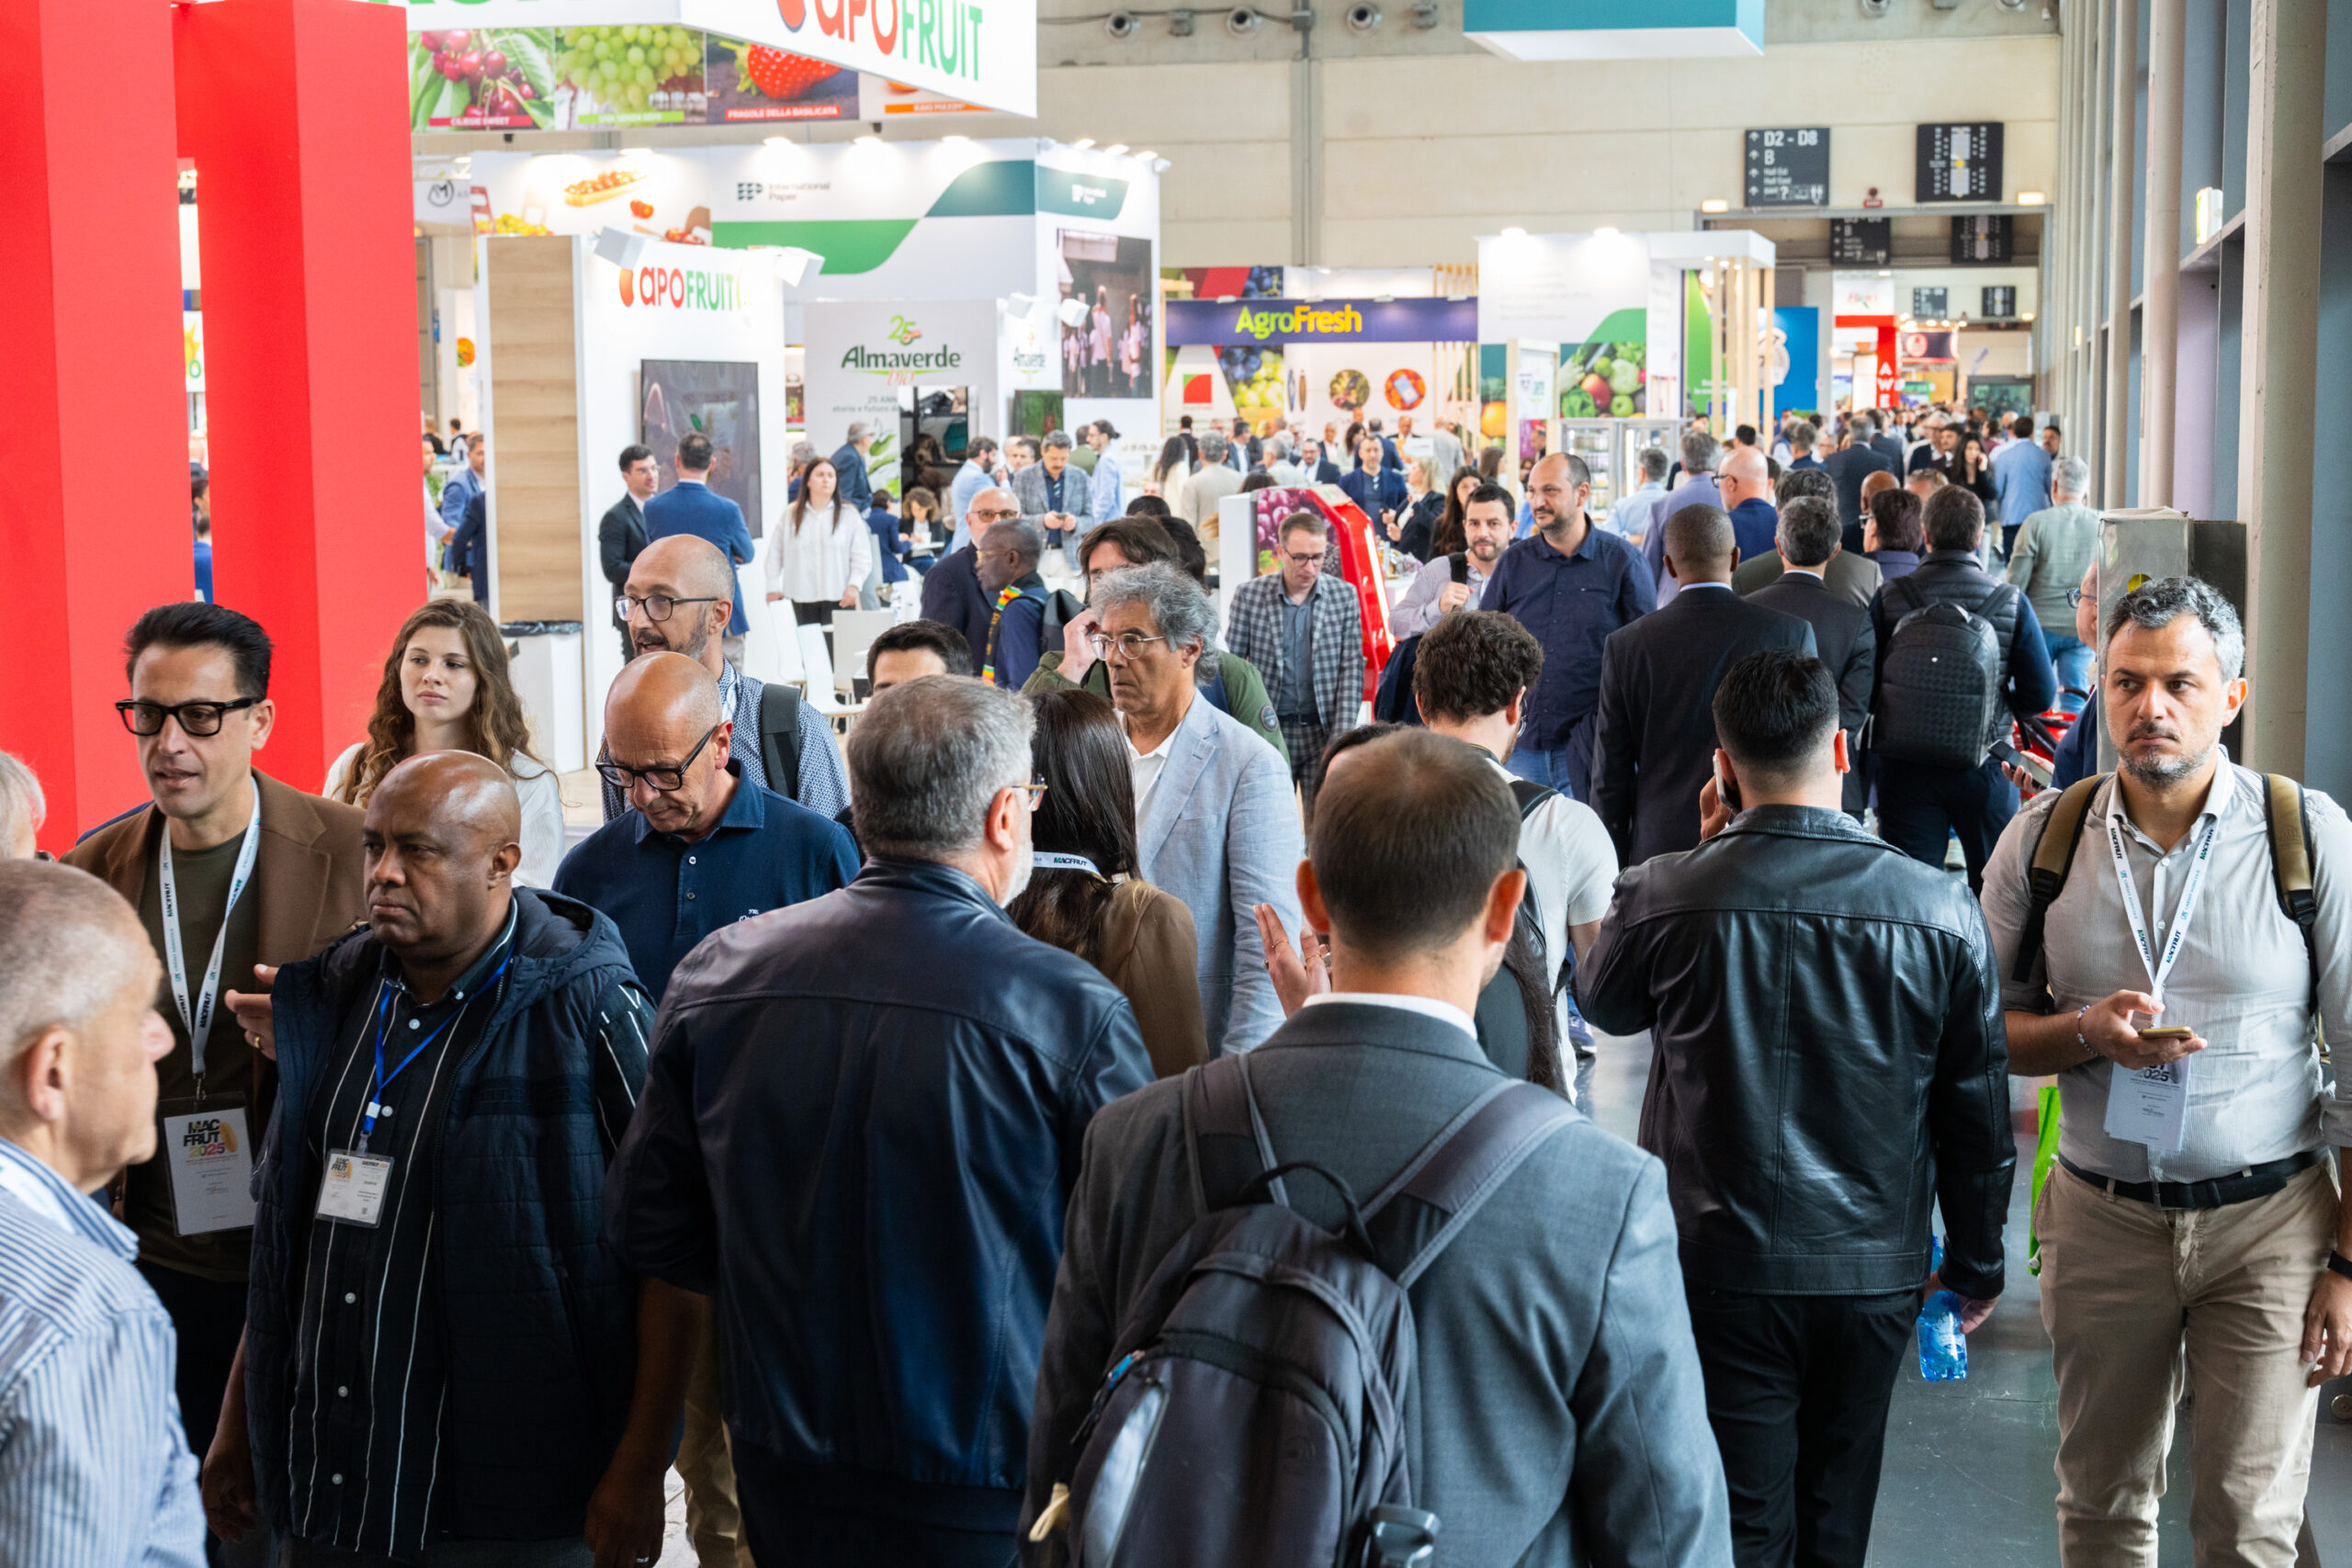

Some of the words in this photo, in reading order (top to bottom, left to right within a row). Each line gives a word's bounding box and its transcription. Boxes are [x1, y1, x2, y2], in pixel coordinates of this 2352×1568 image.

[1764, 130, 1784, 147] D2
[1764, 149, 1775, 165] B
[1235, 304, 1363, 340] AgroFresh
[841, 344, 961, 368] Almaverde
[2110, 828, 2122, 860] MACFRUT
[2199, 829, 2214, 861] MACFRUT
[1053, 856, 1087, 866] MACFRUT
[2165, 931, 2181, 964] MACFRUT
[187, 1119, 220, 1134] MAC
[183, 1131, 220, 1147] FRUT
[189, 1143, 226, 1157] 2025
